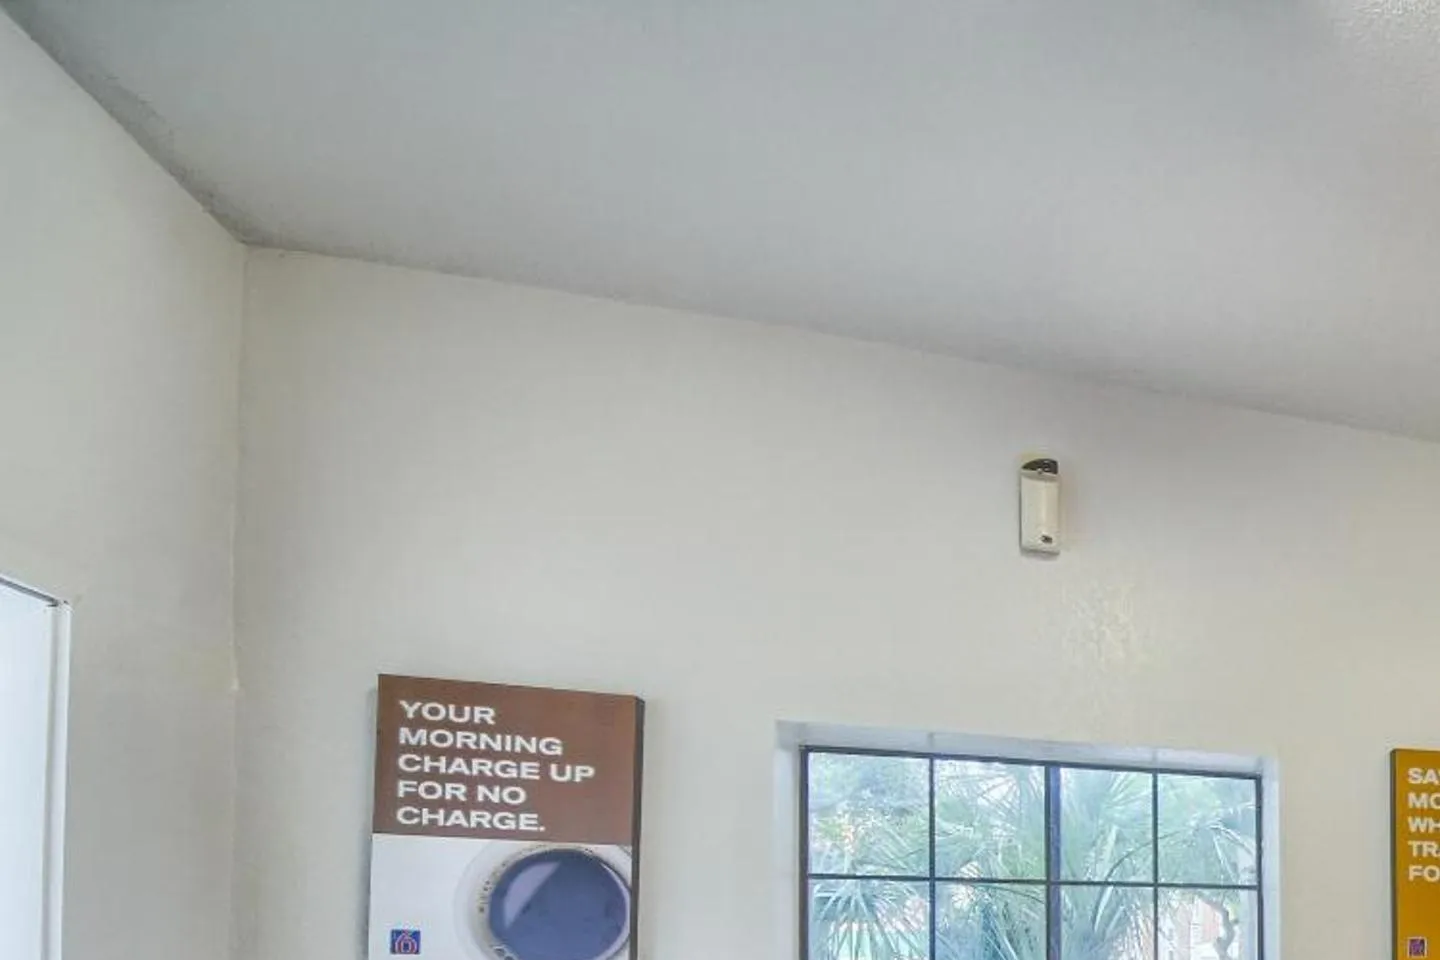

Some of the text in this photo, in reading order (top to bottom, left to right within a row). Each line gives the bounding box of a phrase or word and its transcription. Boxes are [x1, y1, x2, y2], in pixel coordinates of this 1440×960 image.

[399, 700, 496, 725] YOUR
[399, 727, 563, 756] MORNING
[397, 754, 595, 783] CHARGE UP
[397, 780, 527, 806] FOR NO
[396, 806, 546, 833] CHARGE.
